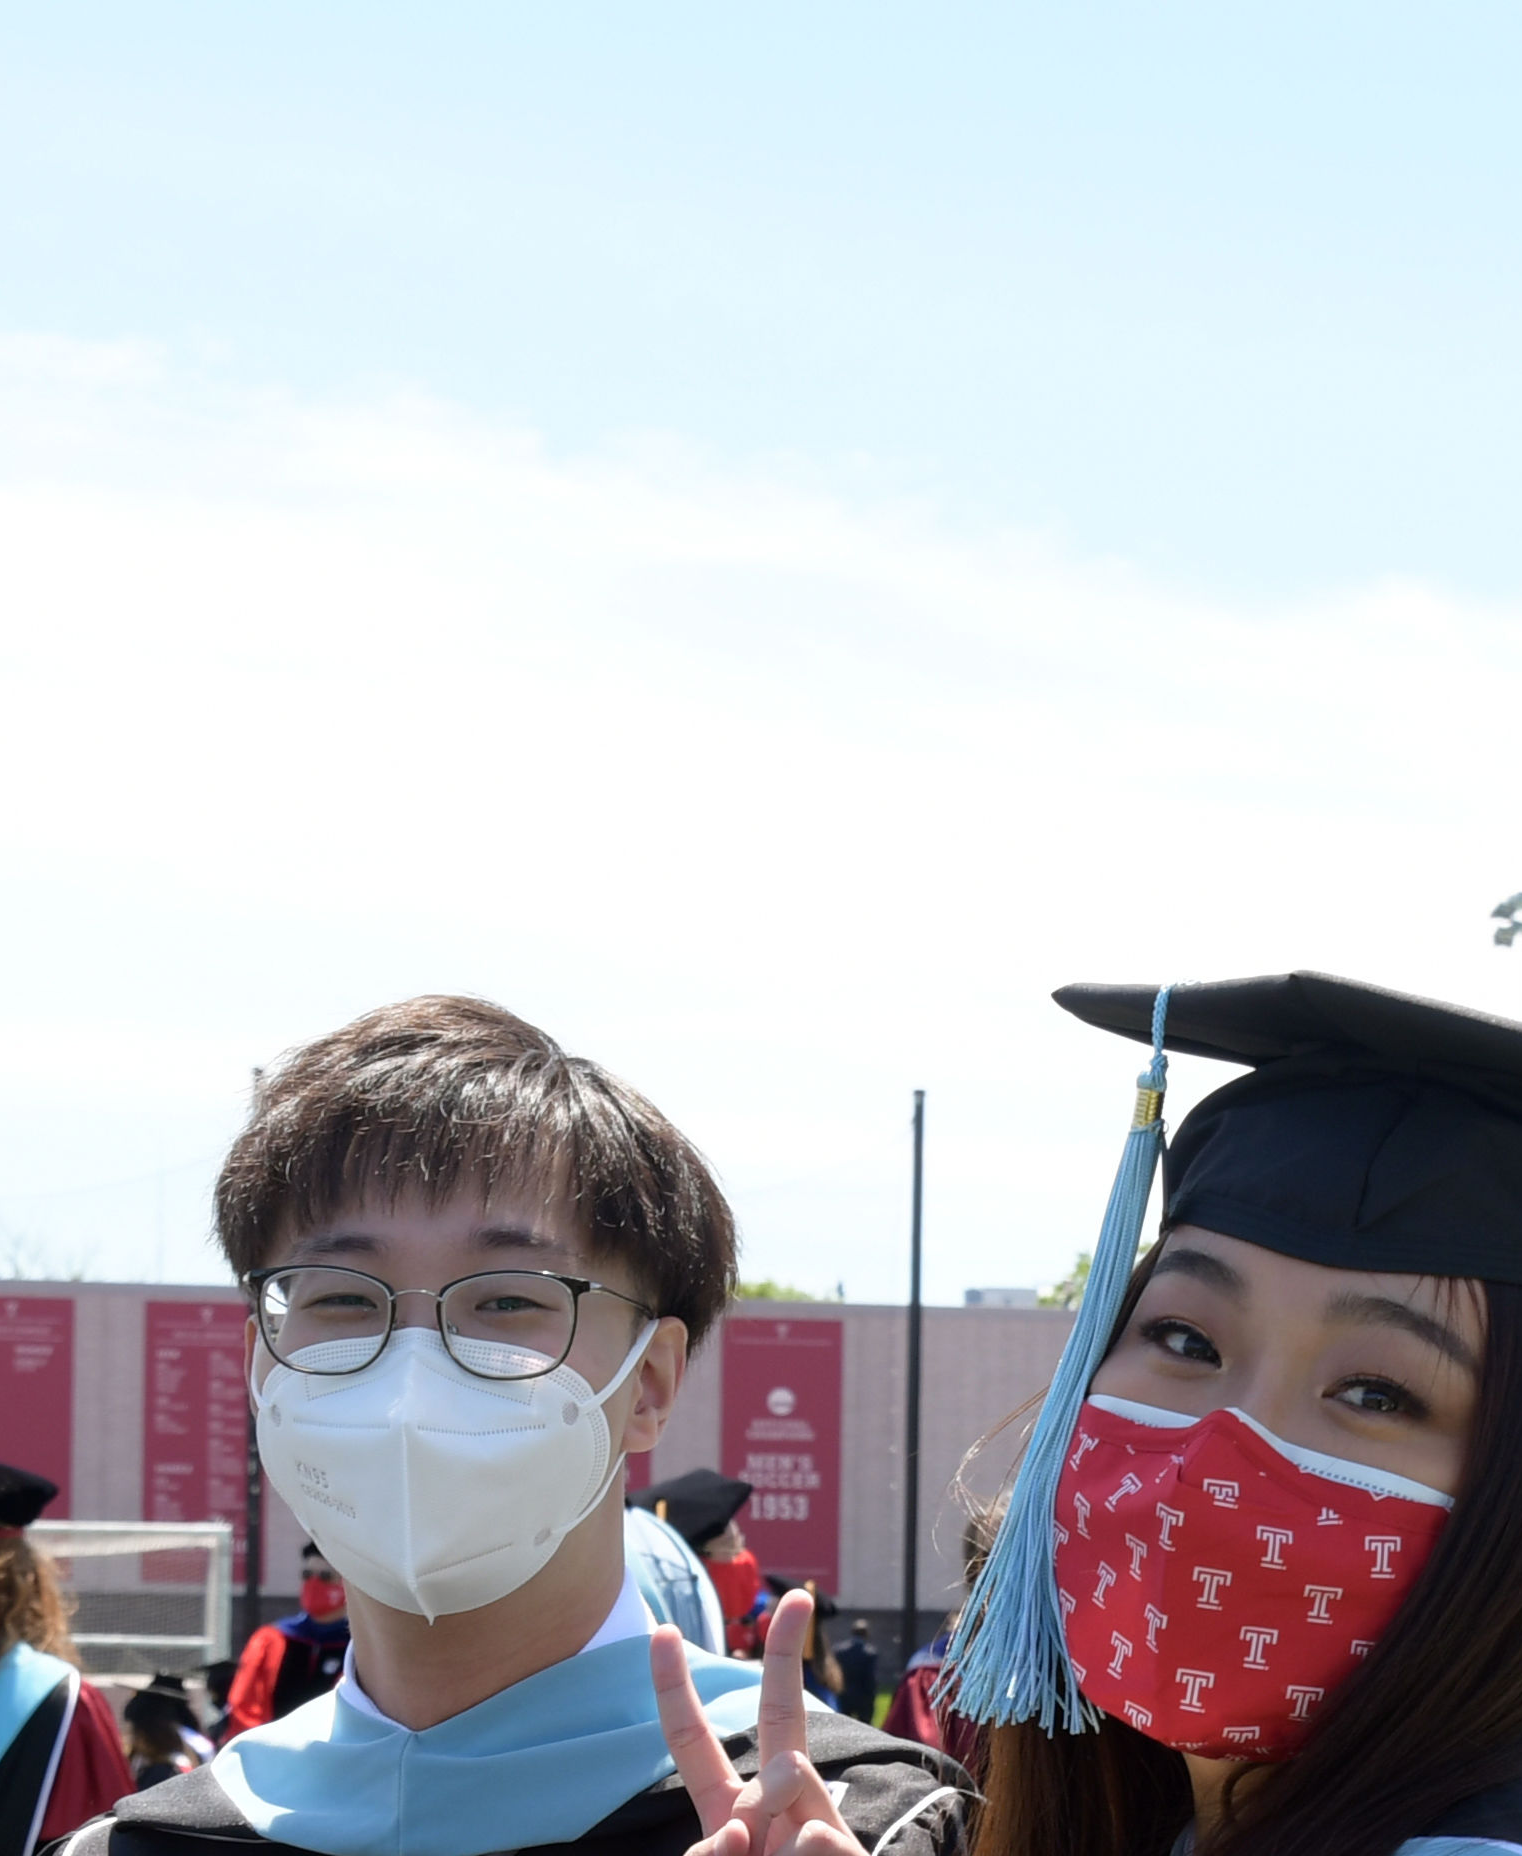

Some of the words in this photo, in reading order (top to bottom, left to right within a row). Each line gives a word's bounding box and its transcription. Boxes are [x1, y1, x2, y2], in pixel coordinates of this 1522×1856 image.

[1069, 1431, 1100, 1472] T
[737, 1471, 821, 1490] SOCCER
[1104, 1471, 1143, 1513] T
[749, 1494, 810, 1520] 1953
[1073, 1491, 1091, 1540] T
[1155, 1501, 1185, 1552] T
[1125, 1532, 1148, 1581] T
[1257, 1525, 1293, 1570] T
[1364, 1536, 1401, 1579] T
[1091, 1560, 1117, 1610] T
[1192, 1566, 1232, 1611] T
[1303, 1584, 1343, 1625] T
[1143, 1603, 1168, 1654] T
[1240, 1626, 1279, 1671] T
[1106, 1630, 1133, 1680] T
[1175, 1668, 1215, 1713] T
[1285, 1684, 1324, 1722] T
